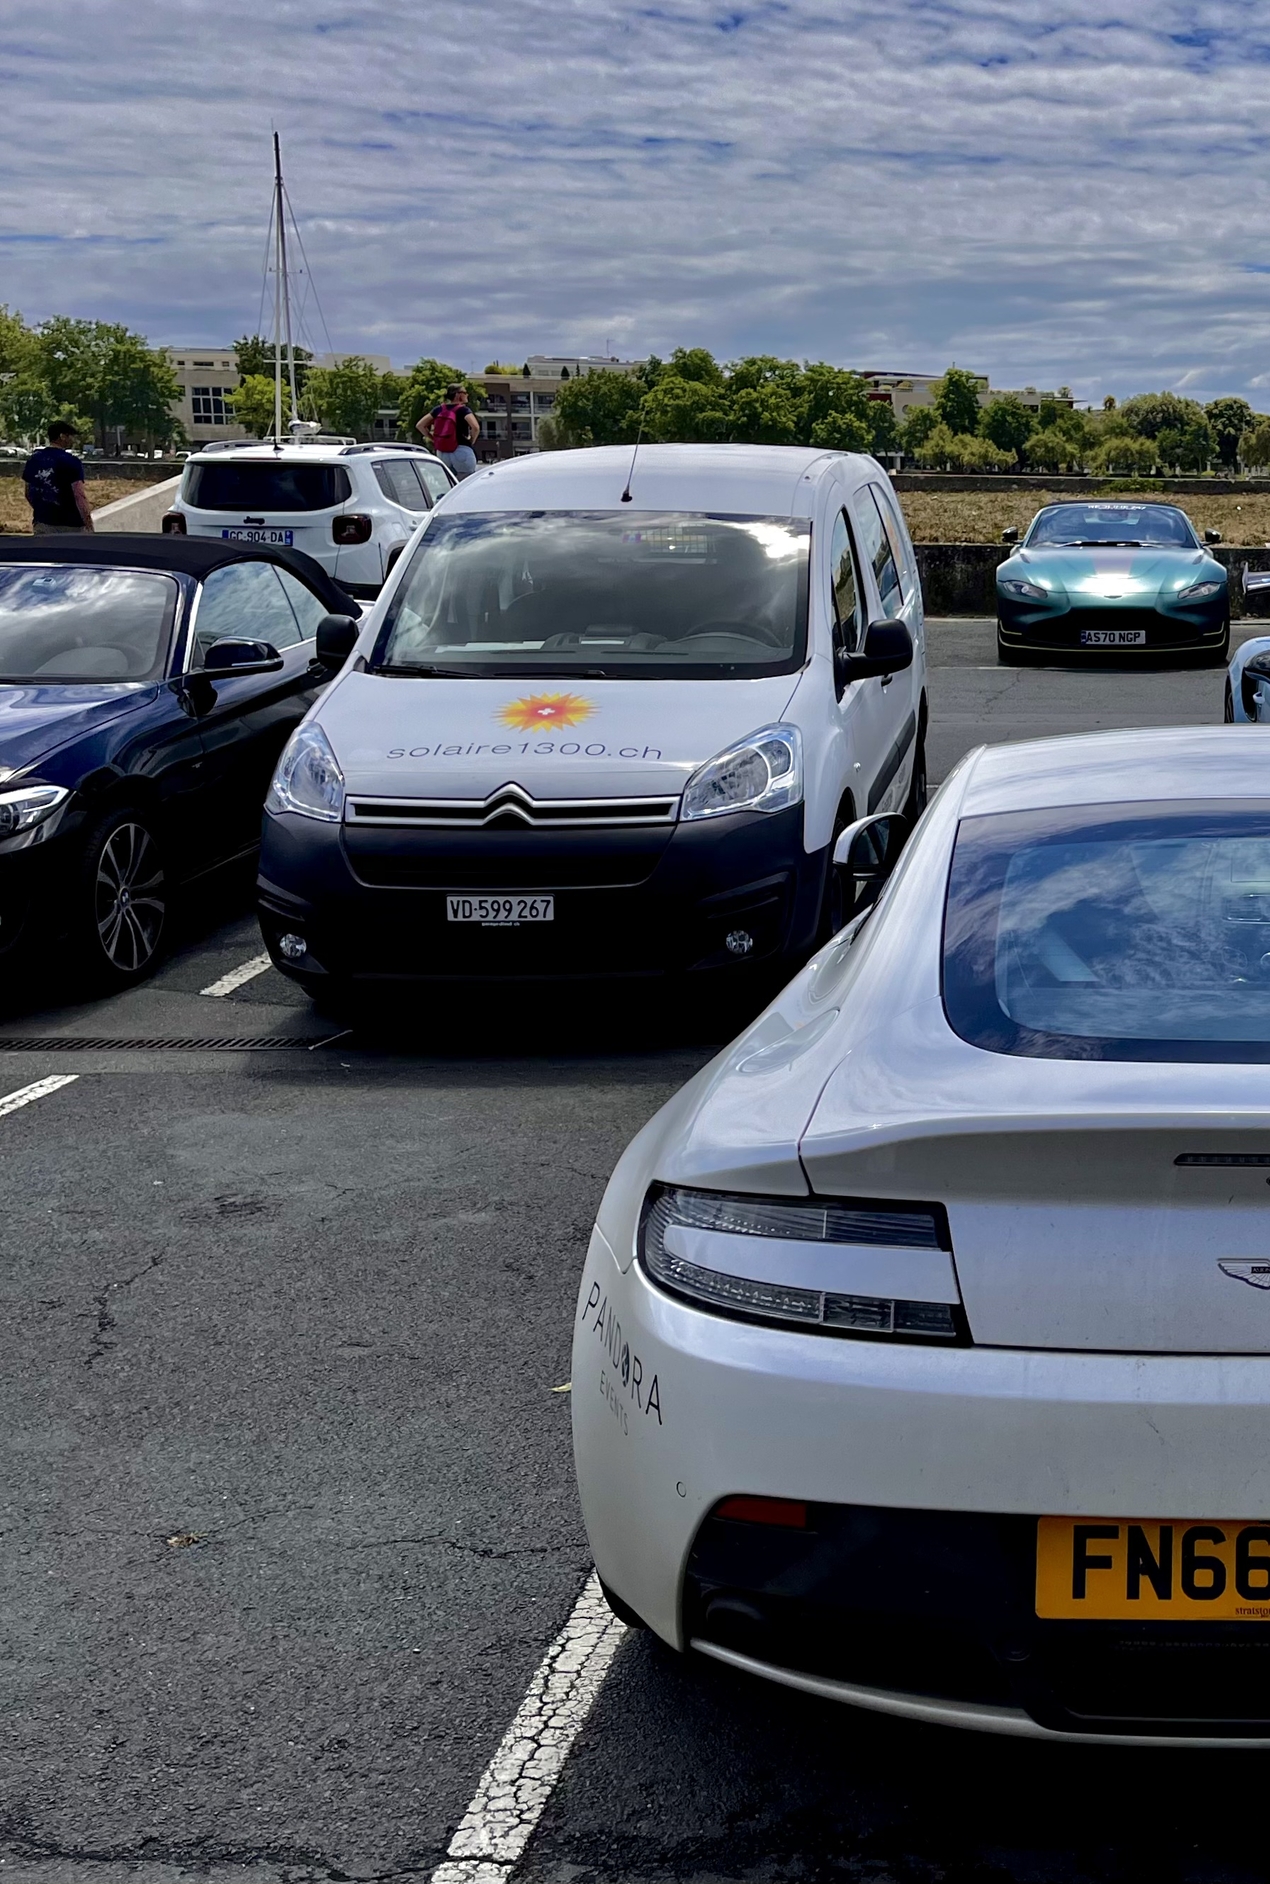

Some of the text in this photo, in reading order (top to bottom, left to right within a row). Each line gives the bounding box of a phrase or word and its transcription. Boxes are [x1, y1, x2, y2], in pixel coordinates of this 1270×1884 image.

[1087, 632, 1141, 643] AS70 NGP
[386, 742, 663, 760] solaire1300.ch
[582, 1281, 662, 1426] PANDORA
[600, 1369, 629, 1437] EVENTS
